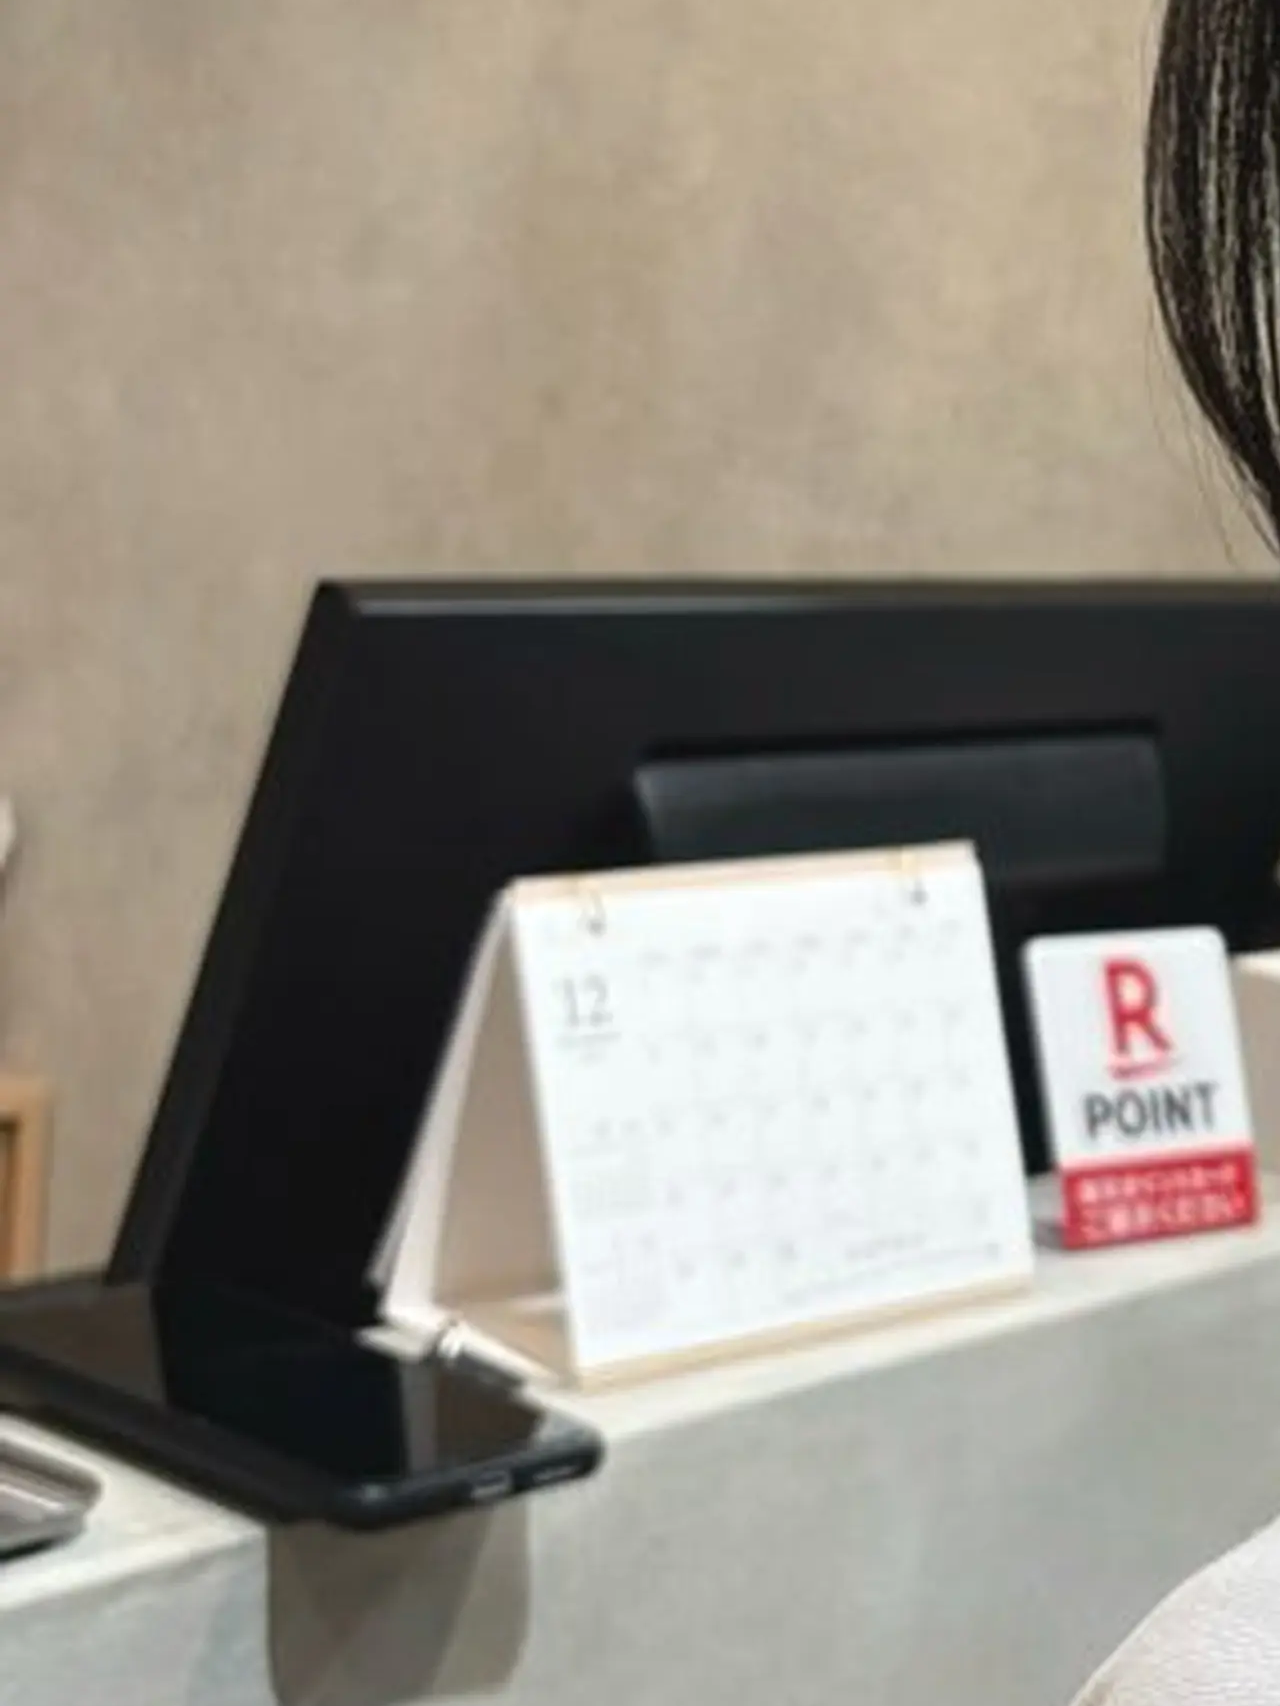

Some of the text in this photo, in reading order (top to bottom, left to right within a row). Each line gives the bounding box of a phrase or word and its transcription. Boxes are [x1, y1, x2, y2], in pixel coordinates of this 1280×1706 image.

[552, 974, 614, 1027] 12
[1102, 959, 1171, 1055] R
[1083, 1082, 1219, 1139] POINT
